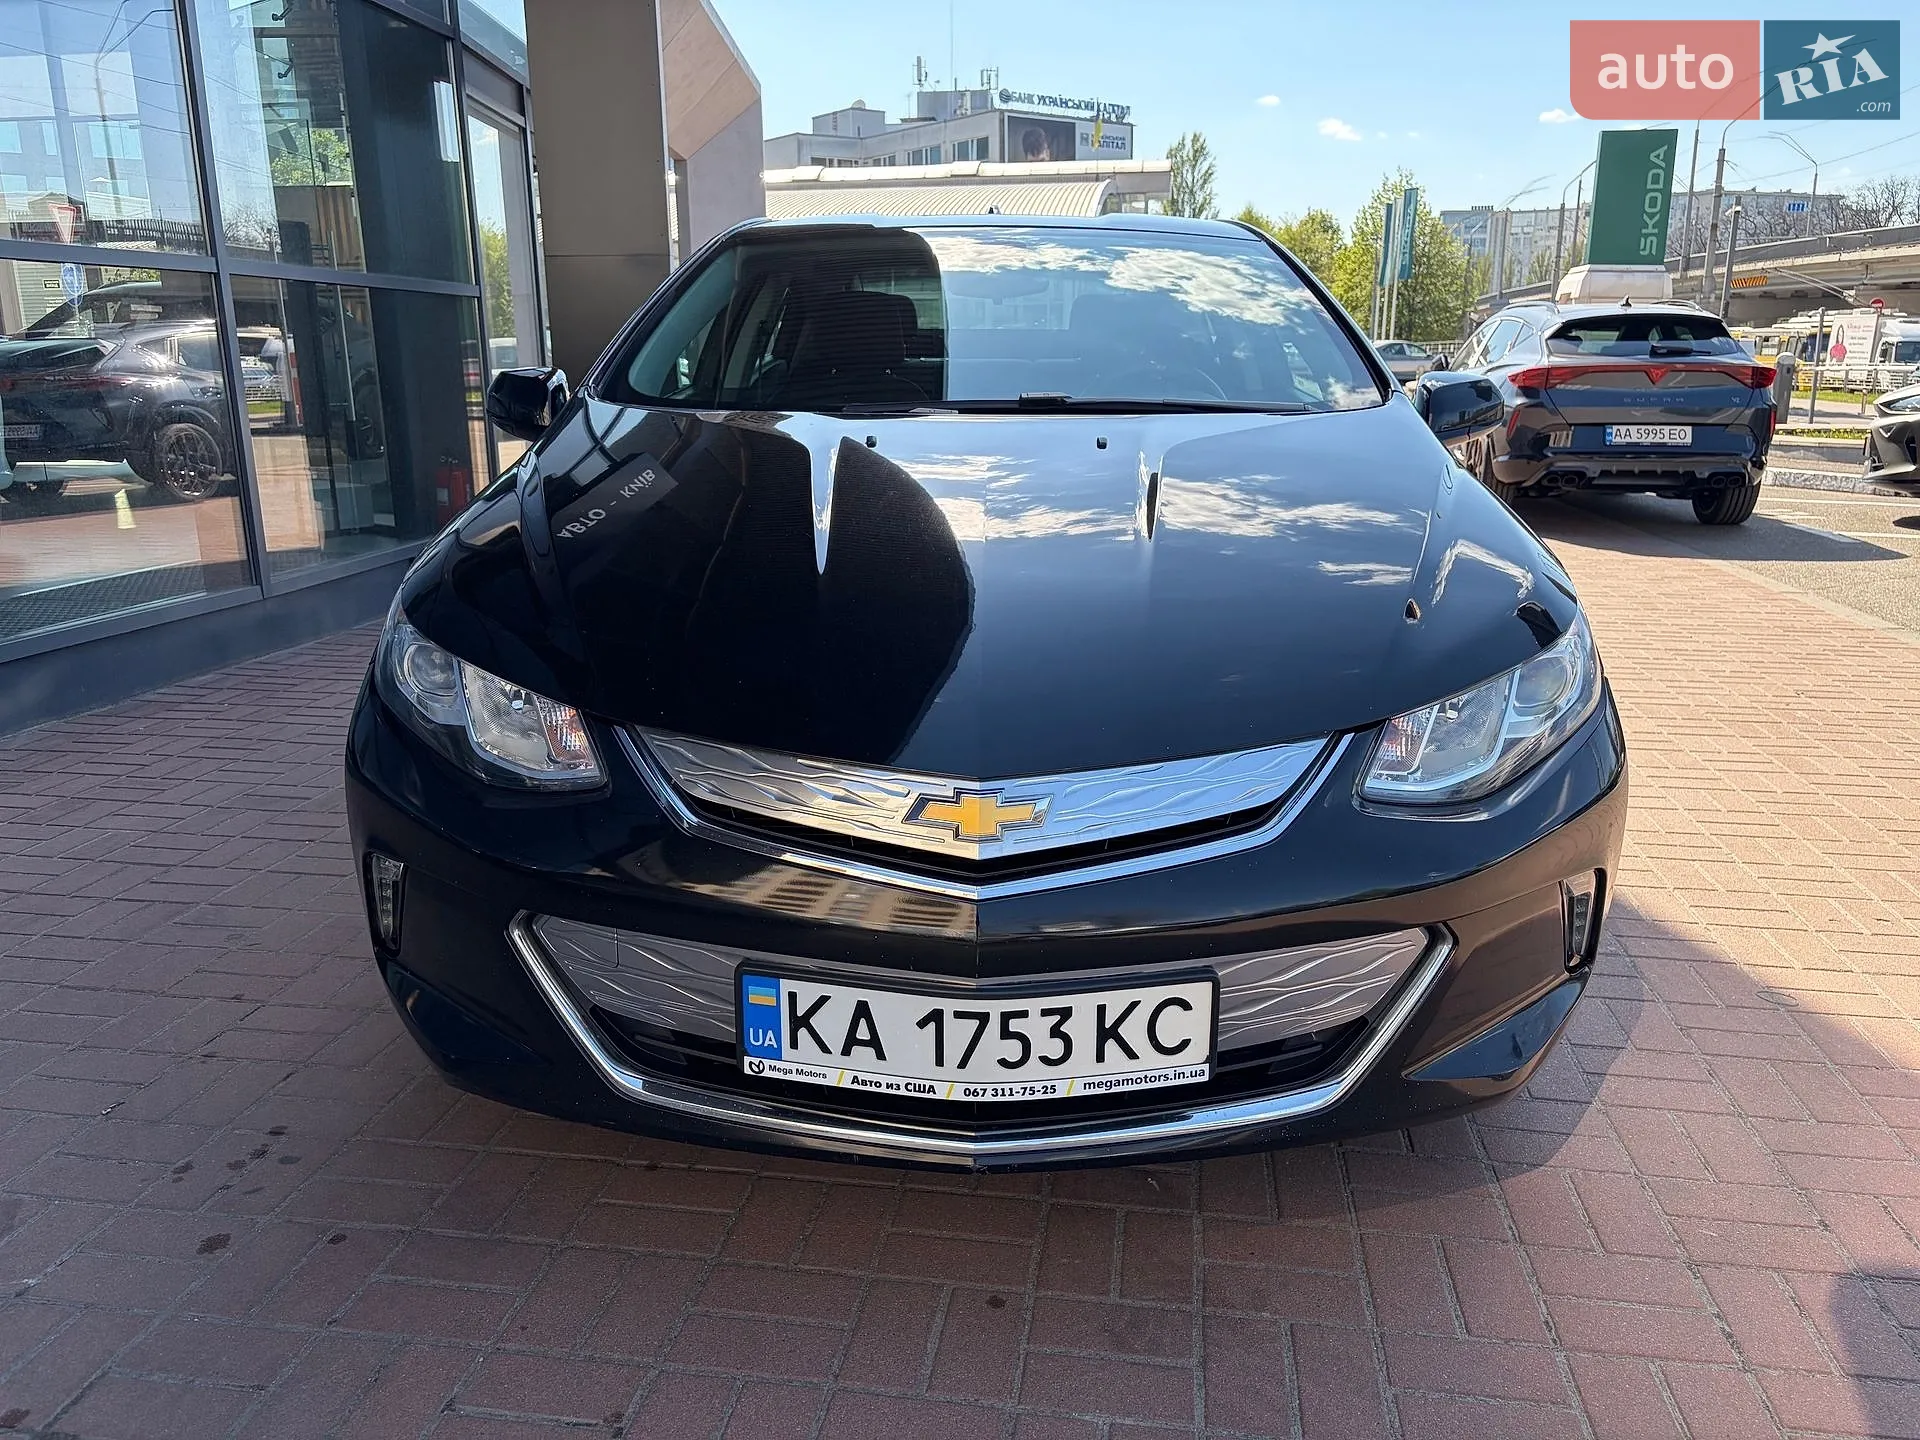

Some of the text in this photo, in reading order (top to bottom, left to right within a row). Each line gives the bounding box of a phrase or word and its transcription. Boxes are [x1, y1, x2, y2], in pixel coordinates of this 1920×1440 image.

[1011, 91, 1035, 105] БАНК
[1613, 428, 1633, 440] AA
[1636, 427, 1665, 440] 5995
[750, 1028, 777, 1049] UA
[787, 990, 1193, 1070] KA 1753 KC
[768, 1064, 828, 1080] Mega Motors
[1083, 1067, 1206, 1092] megamotors.in.ua
[850, 1075, 937, 1095] Авто из США
[963, 1084, 1057, 1098] 067 311-75-25
